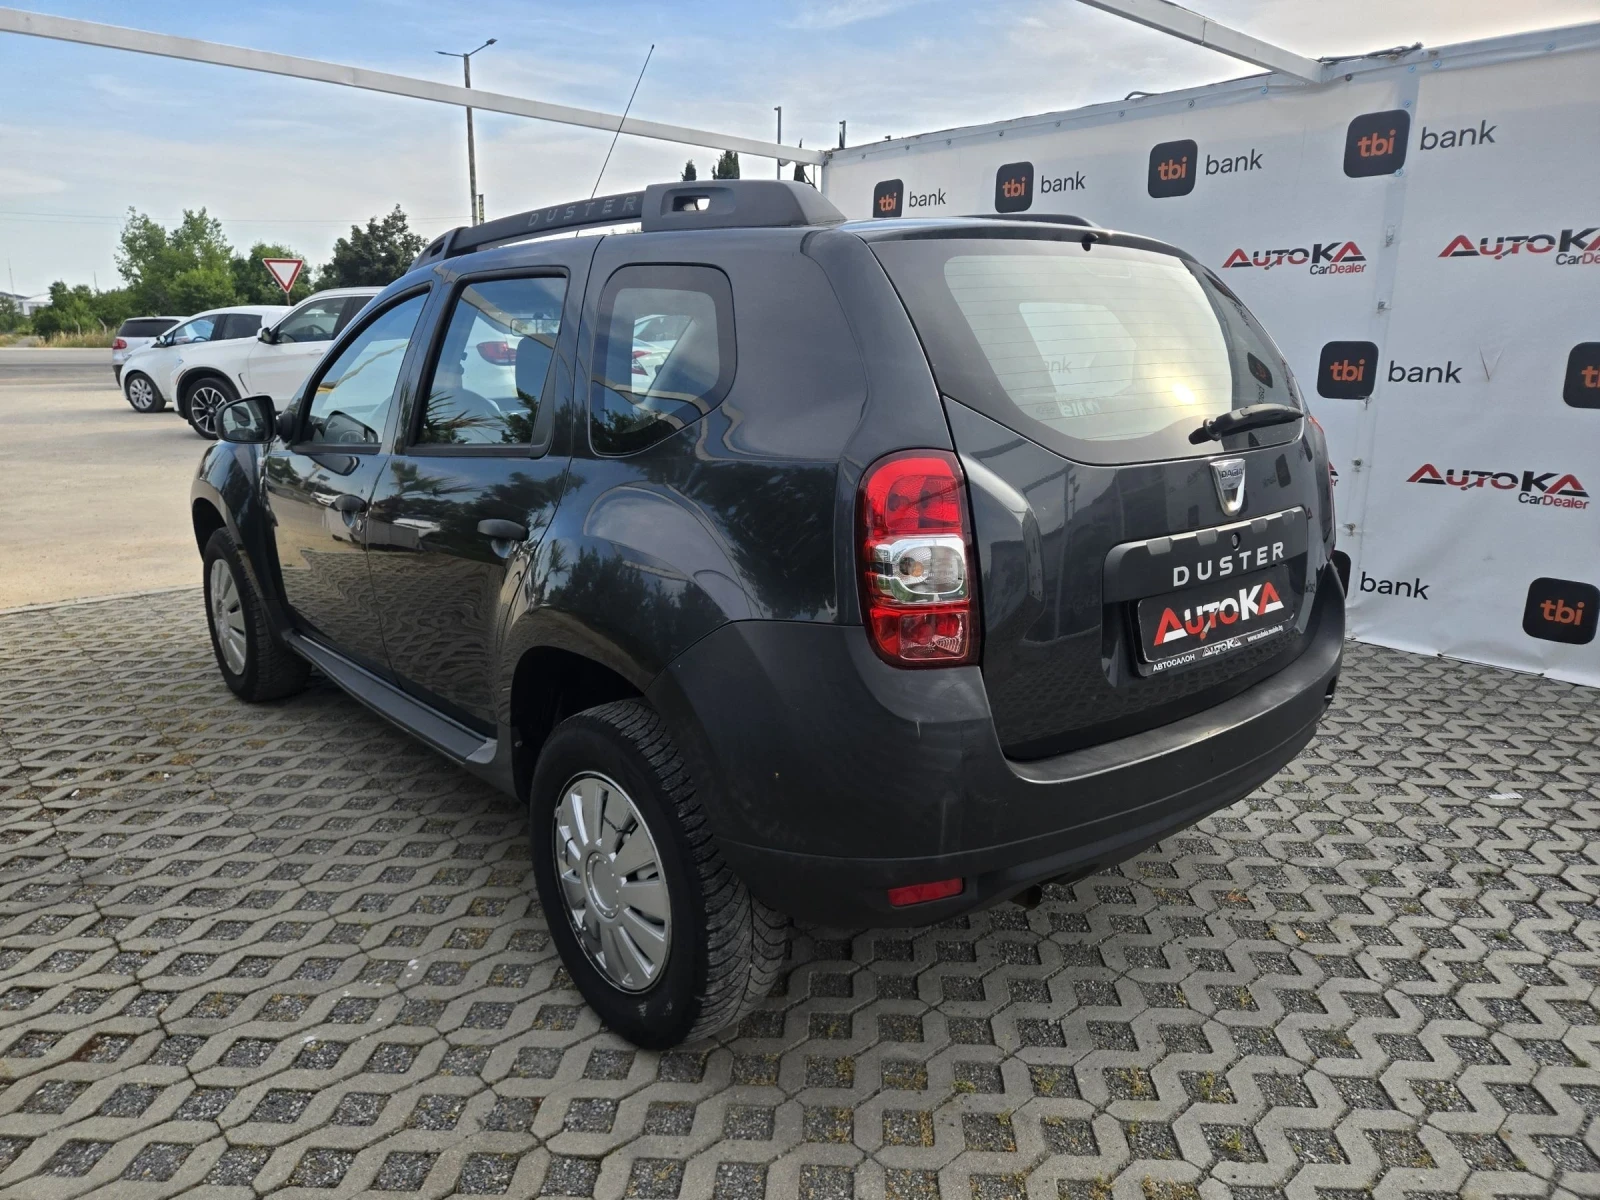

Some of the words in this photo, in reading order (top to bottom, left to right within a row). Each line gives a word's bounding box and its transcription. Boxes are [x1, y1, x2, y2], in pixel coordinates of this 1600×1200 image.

[1357, 129, 1397, 158] tbi
[1420, 120, 1498, 151] bank
[1157, 156, 1187, 181] tbi
[1205, 148, 1264, 175] bank
[1002, 176, 1026, 197] tbi
[1040, 171, 1087, 194] bank
[527, 194, 637, 227] DUSTER
[878, 192, 897, 212] tbi
[908, 188, 947, 208] bank
[1330, 358, 1366, 382] tbi
[1387, 360, 1463, 384] bank
[1173, 541, 1285, 588] DUSTER
[1360, 571, 1430, 600] bank
[1540, 599, 1586, 626] tbi
[1153, 653, 1196, 672] АВТОСАЛОН
